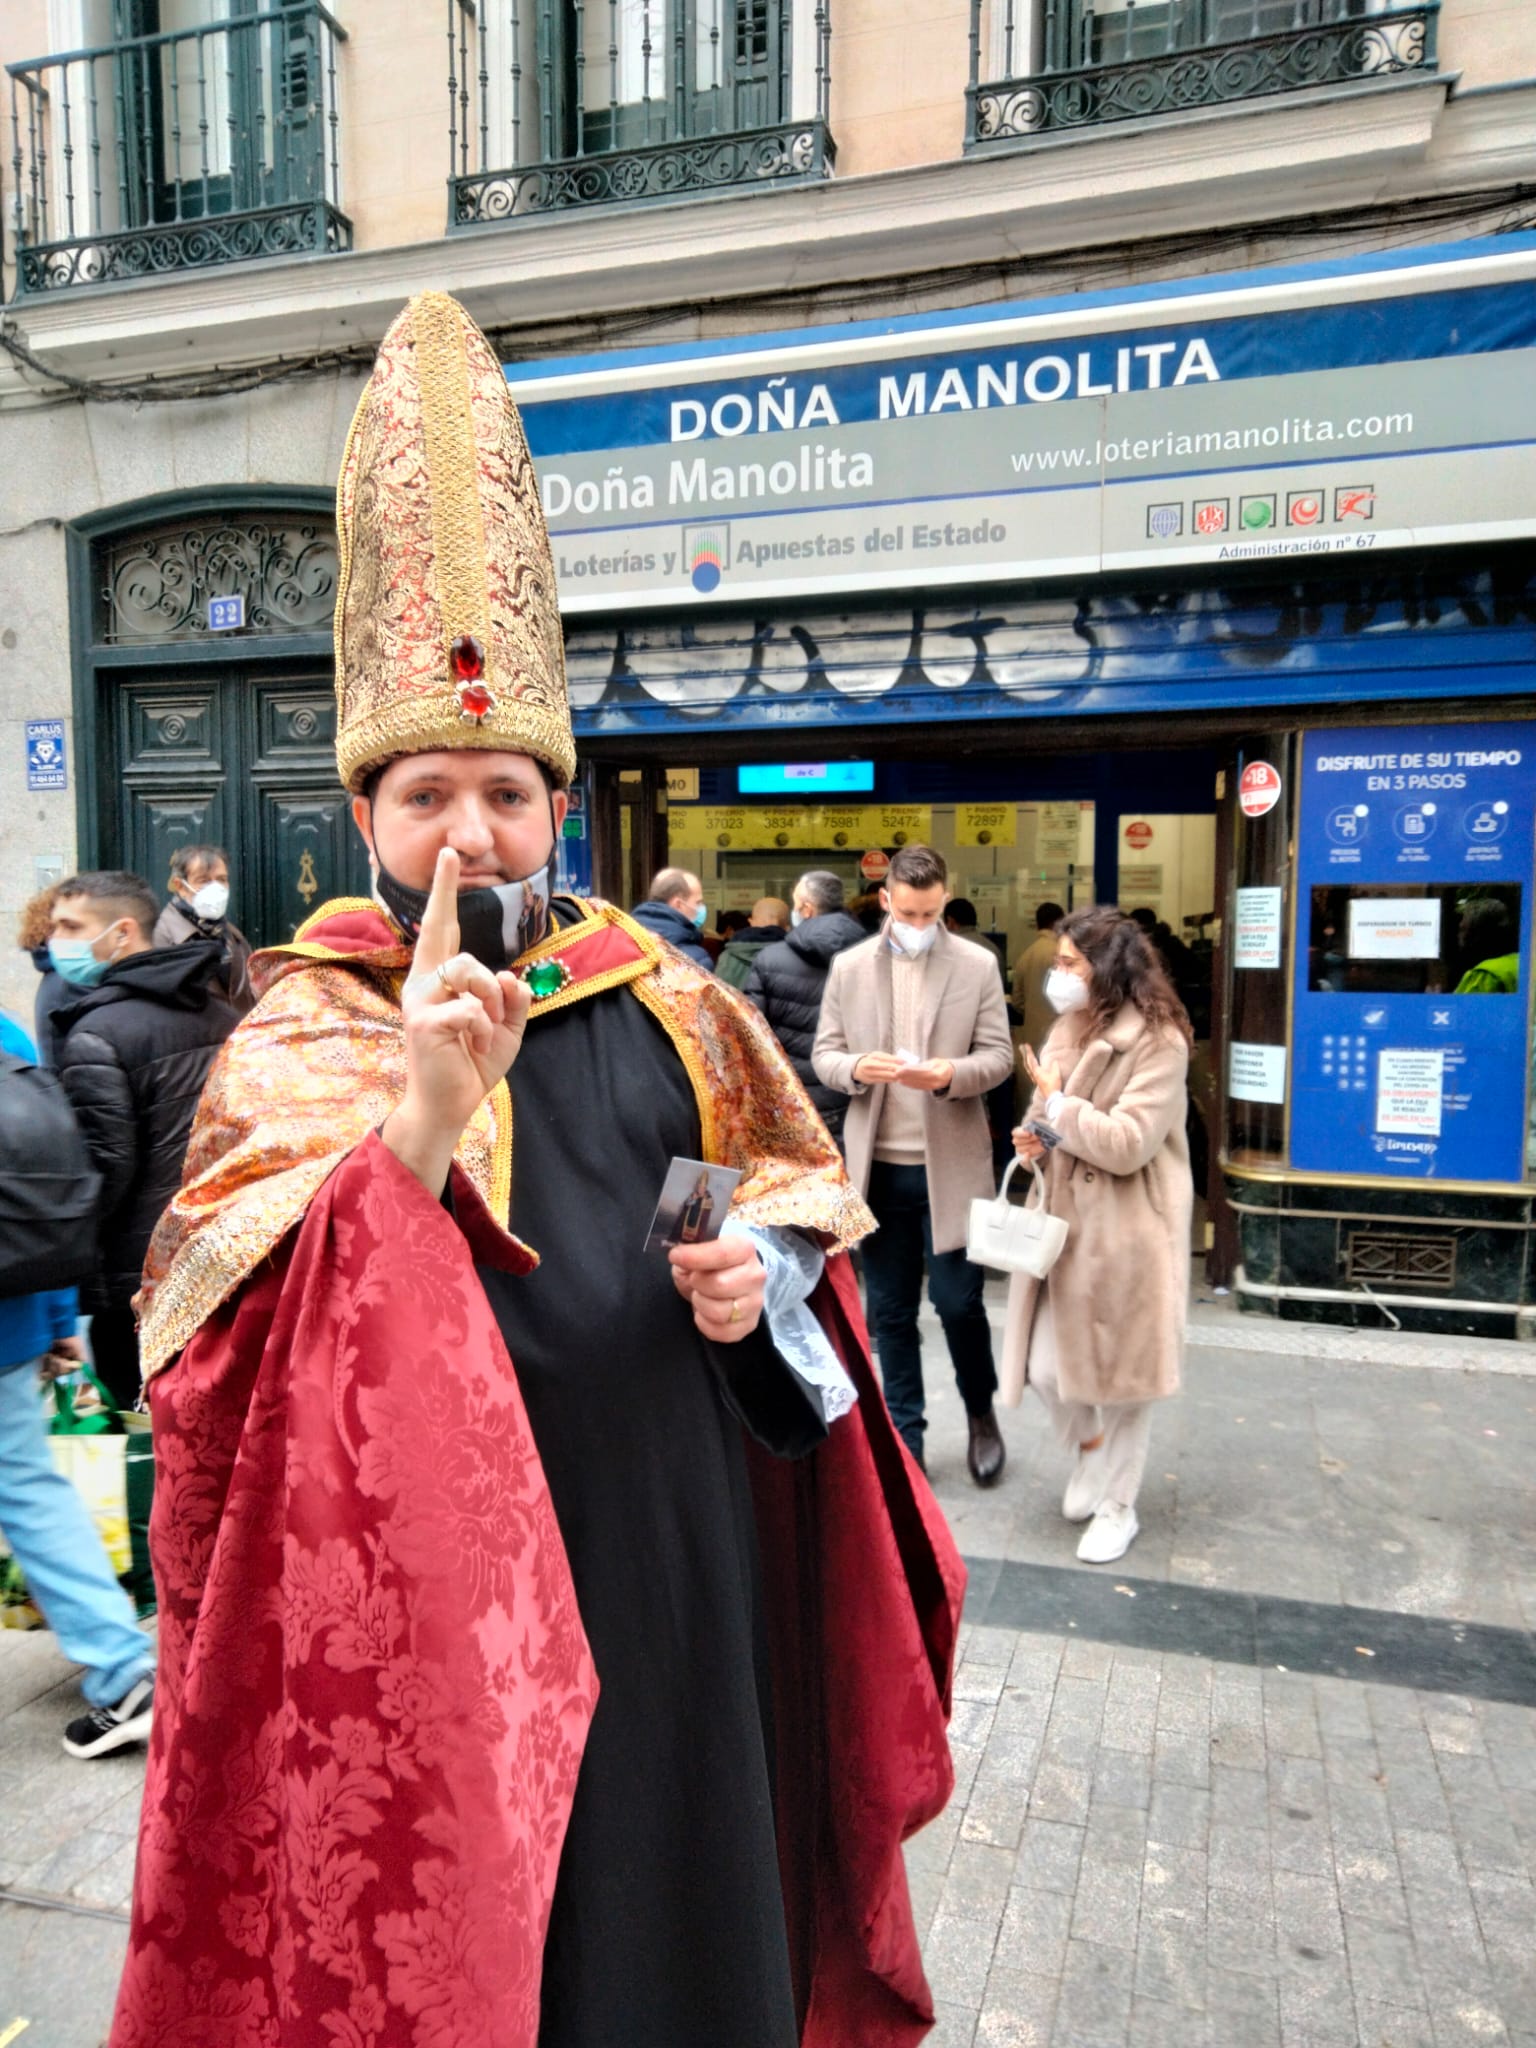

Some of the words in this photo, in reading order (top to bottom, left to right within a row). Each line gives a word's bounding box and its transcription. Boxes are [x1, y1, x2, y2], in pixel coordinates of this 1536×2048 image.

[670, 377, 840, 442] DOÑA
[879, 338, 1220, 420] MANOLITA
[1011, 411, 1414, 473] www.loteriamanolita.com
[542, 466, 654, 518] Doña
[668, 445, 874, 504] Manolita
[736, 537, 855, 566] Apuestas
[864, 525, 903, 553] del
[912, 517, 1006, 549] Estado
[1219, 539, 1331, 560] Administración
[1356, 534, 1377, 548] 67
[560, 548, 656, 579] Loterías
[662, 551, 677, 576] y
[214, 602, 237, 625] 22
[1316, 754, 1397, 772] DISFRUTE
[1400, 753, 1420, 769] DE
[1426, 752, 1450, 768] SU
[1454, 750, 1522, 767] TIEMPO
[1367, 776, 1390, 791] EN
[1393, 775, 1405, 790] 3
[1408, 773, 1467, 789] PASOS
[706, 818, 743, 829] 37023
[882, 816, 920, 828] 52472
[967, 815, 1005, 827] 72897
